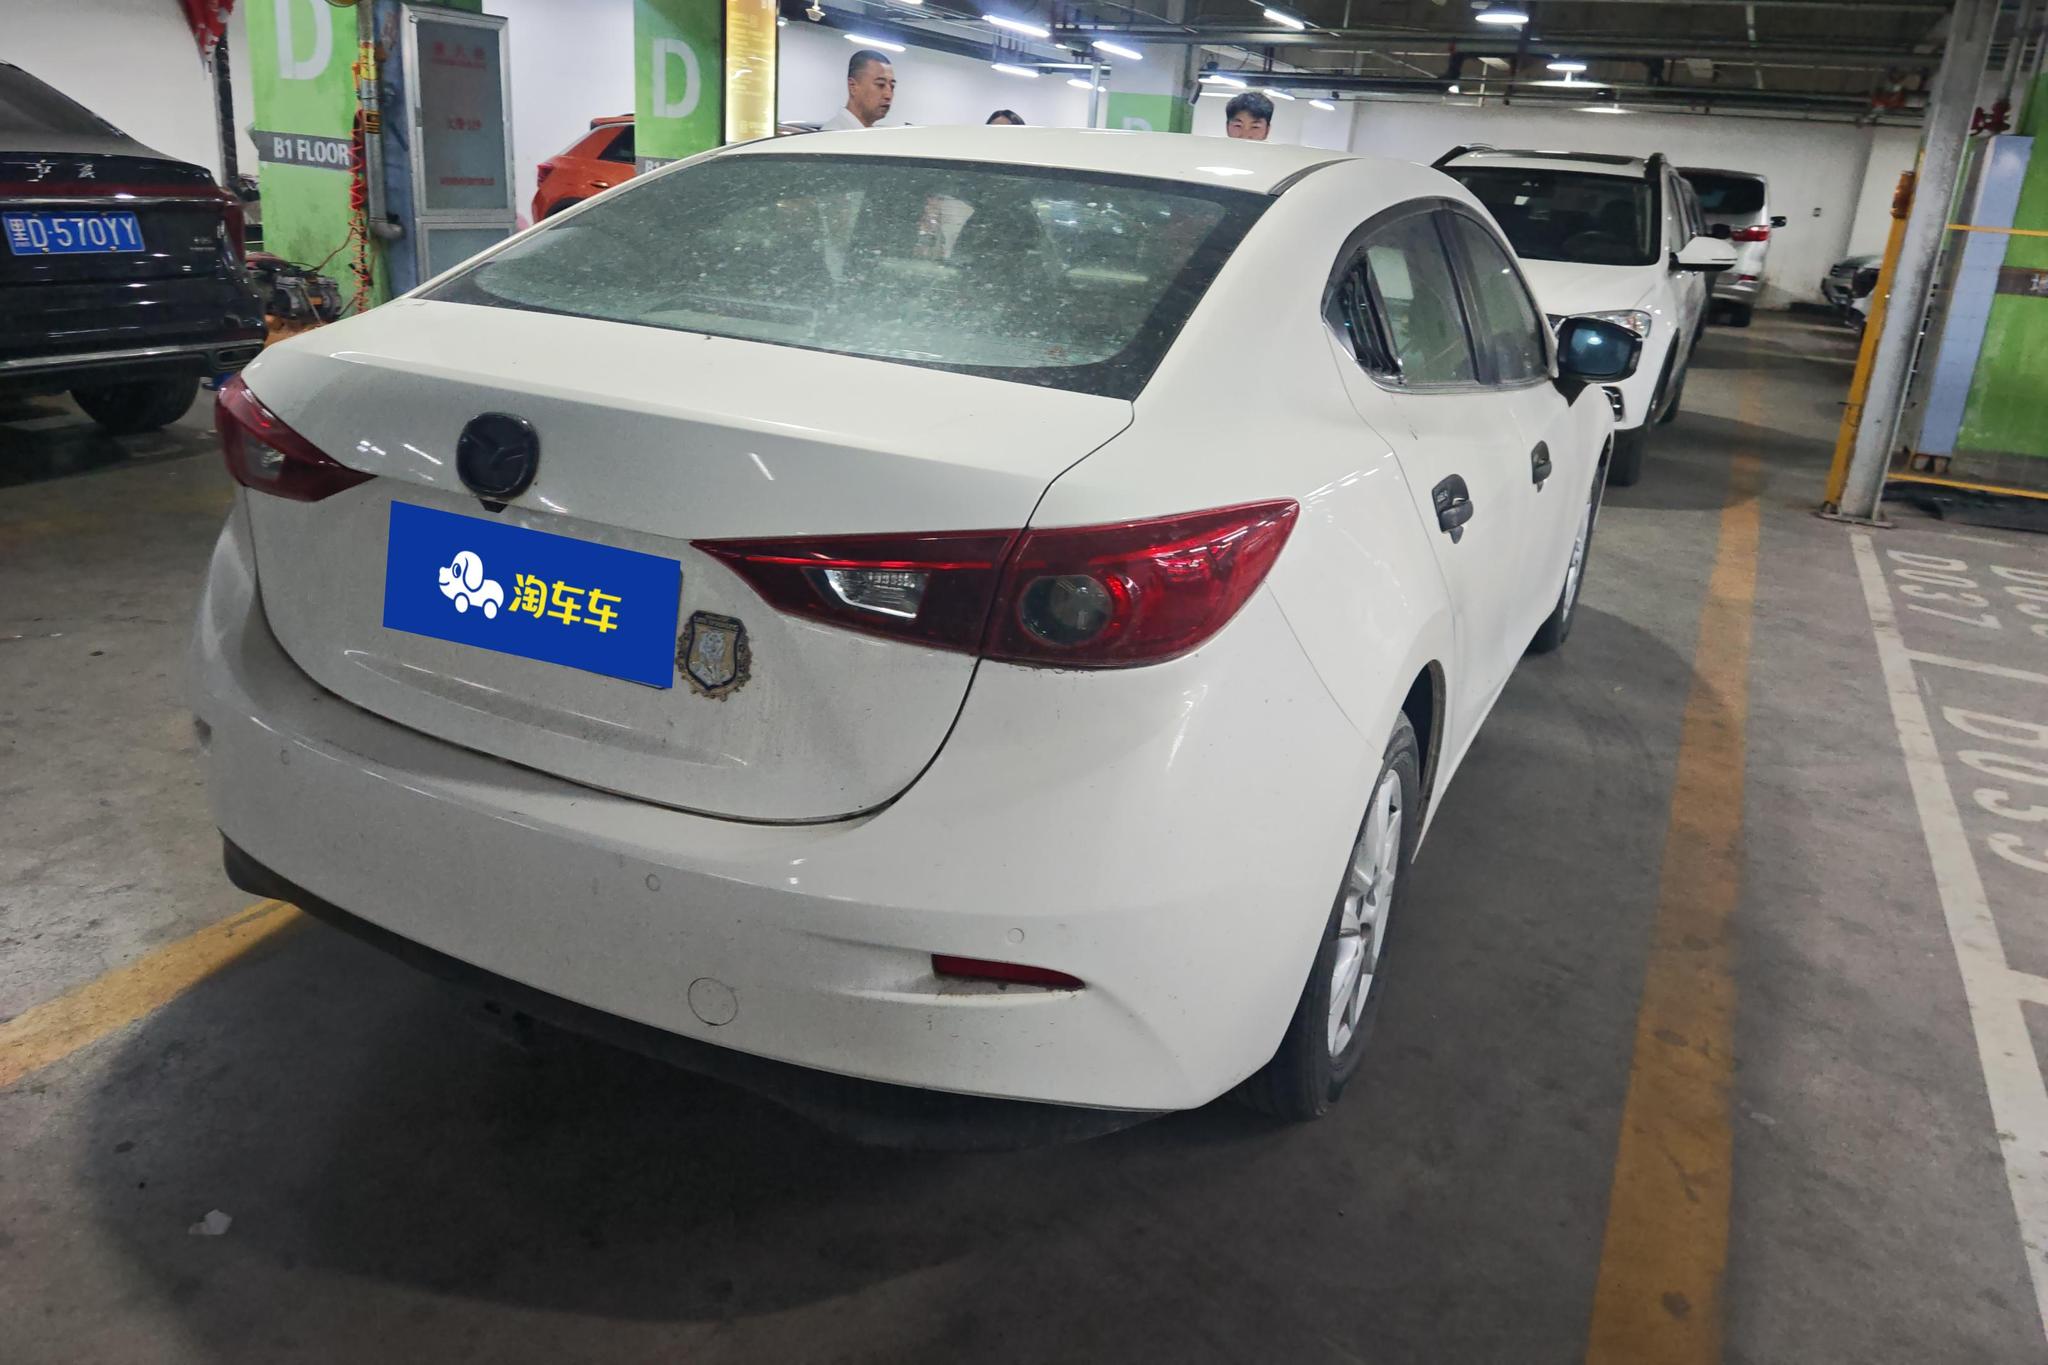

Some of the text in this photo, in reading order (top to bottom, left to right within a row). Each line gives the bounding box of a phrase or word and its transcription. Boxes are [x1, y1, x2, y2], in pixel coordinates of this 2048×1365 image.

[274, 0, 332, 80] D
[652, 37, 700, 118] D
[273, 136, 349, 165] B1 FLOOR
[1990, 564, 2048, 638] D0
